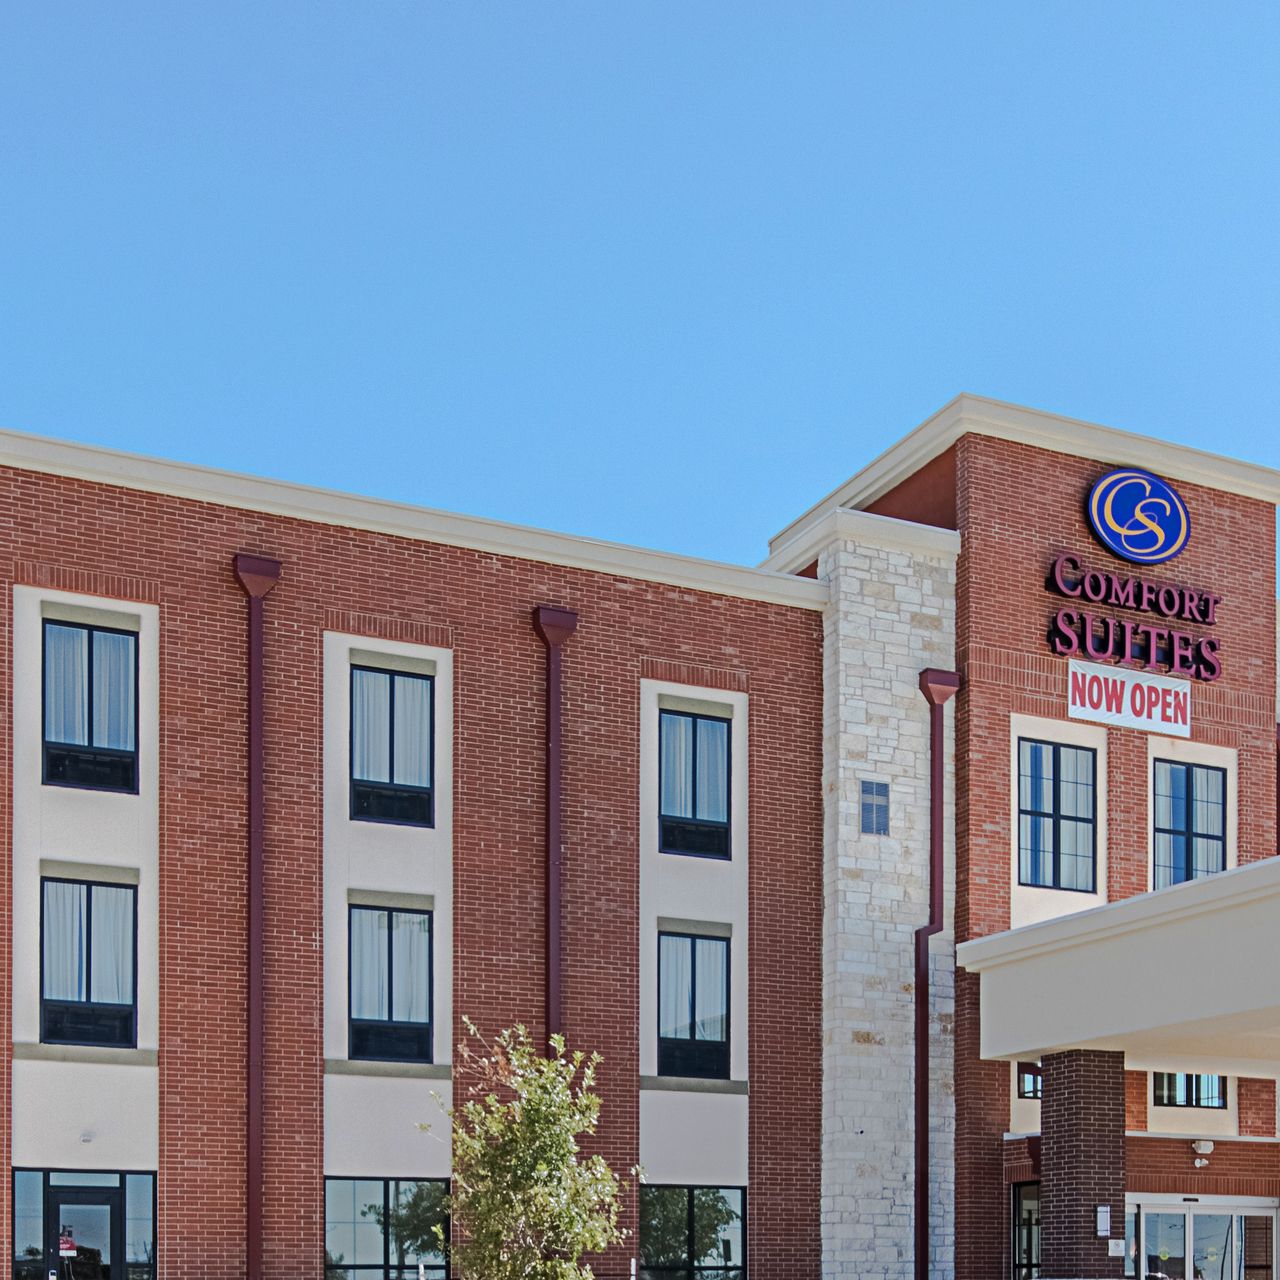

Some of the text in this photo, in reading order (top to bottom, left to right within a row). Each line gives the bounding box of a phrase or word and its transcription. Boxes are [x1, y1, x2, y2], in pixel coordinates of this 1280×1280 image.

[1054, 553, 1222, 624] COMFORT
[1054, 608, 1222, 681] SUITES
[1071, 671, 1188, 726] NOW OPEN
